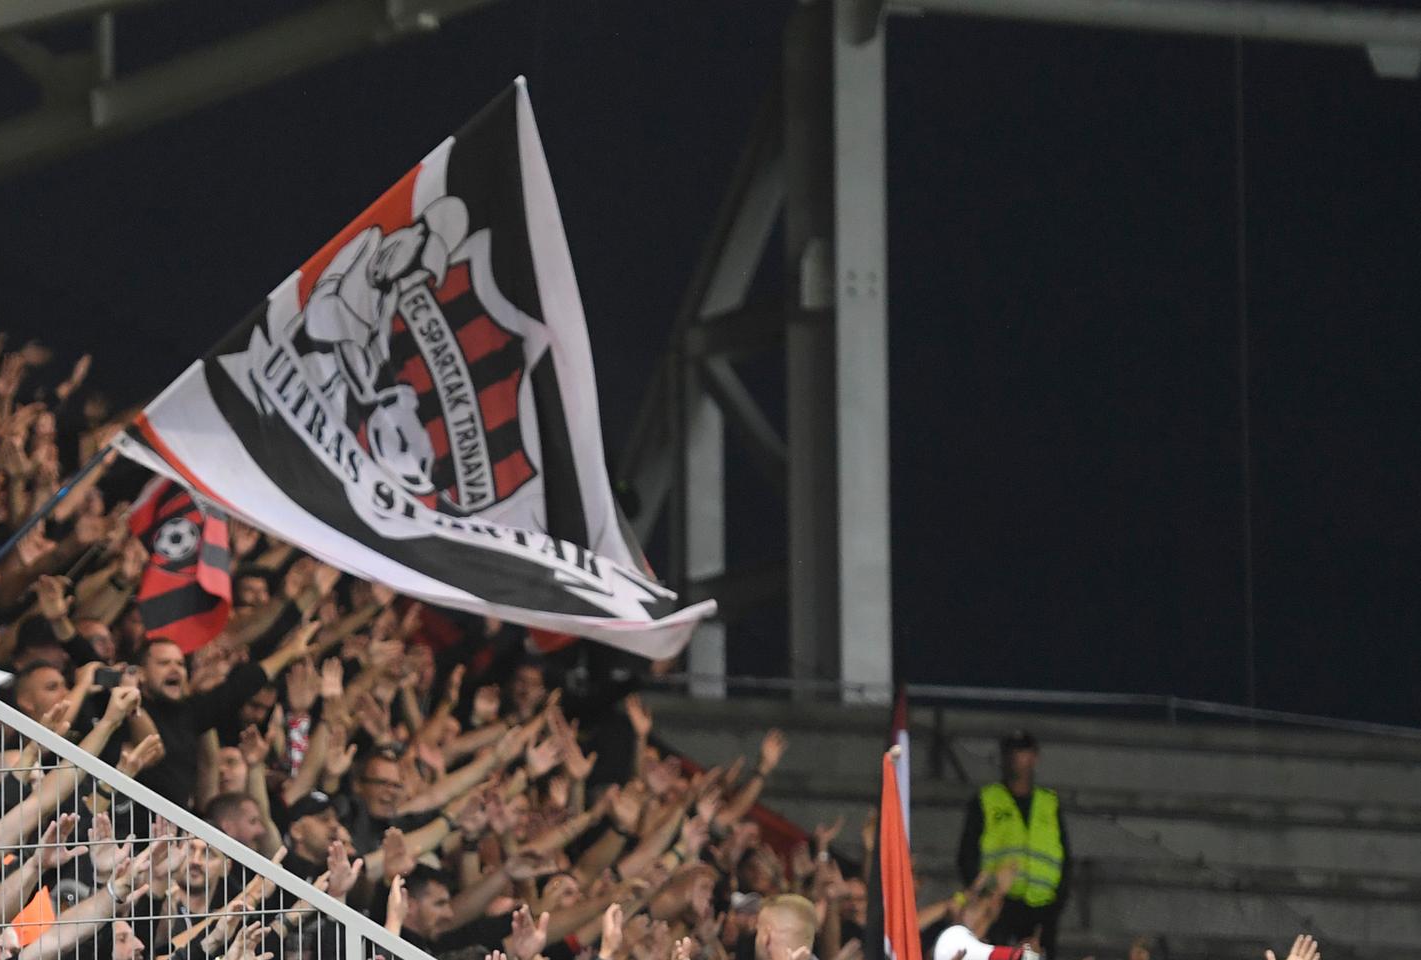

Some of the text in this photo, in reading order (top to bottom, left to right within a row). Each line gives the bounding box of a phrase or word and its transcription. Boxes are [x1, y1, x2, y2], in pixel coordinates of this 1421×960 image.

[263, 346, 605, 581] ULTRAS SRTAK
[404, 294, 490, 508] FC SPARTAK TRNAVA
